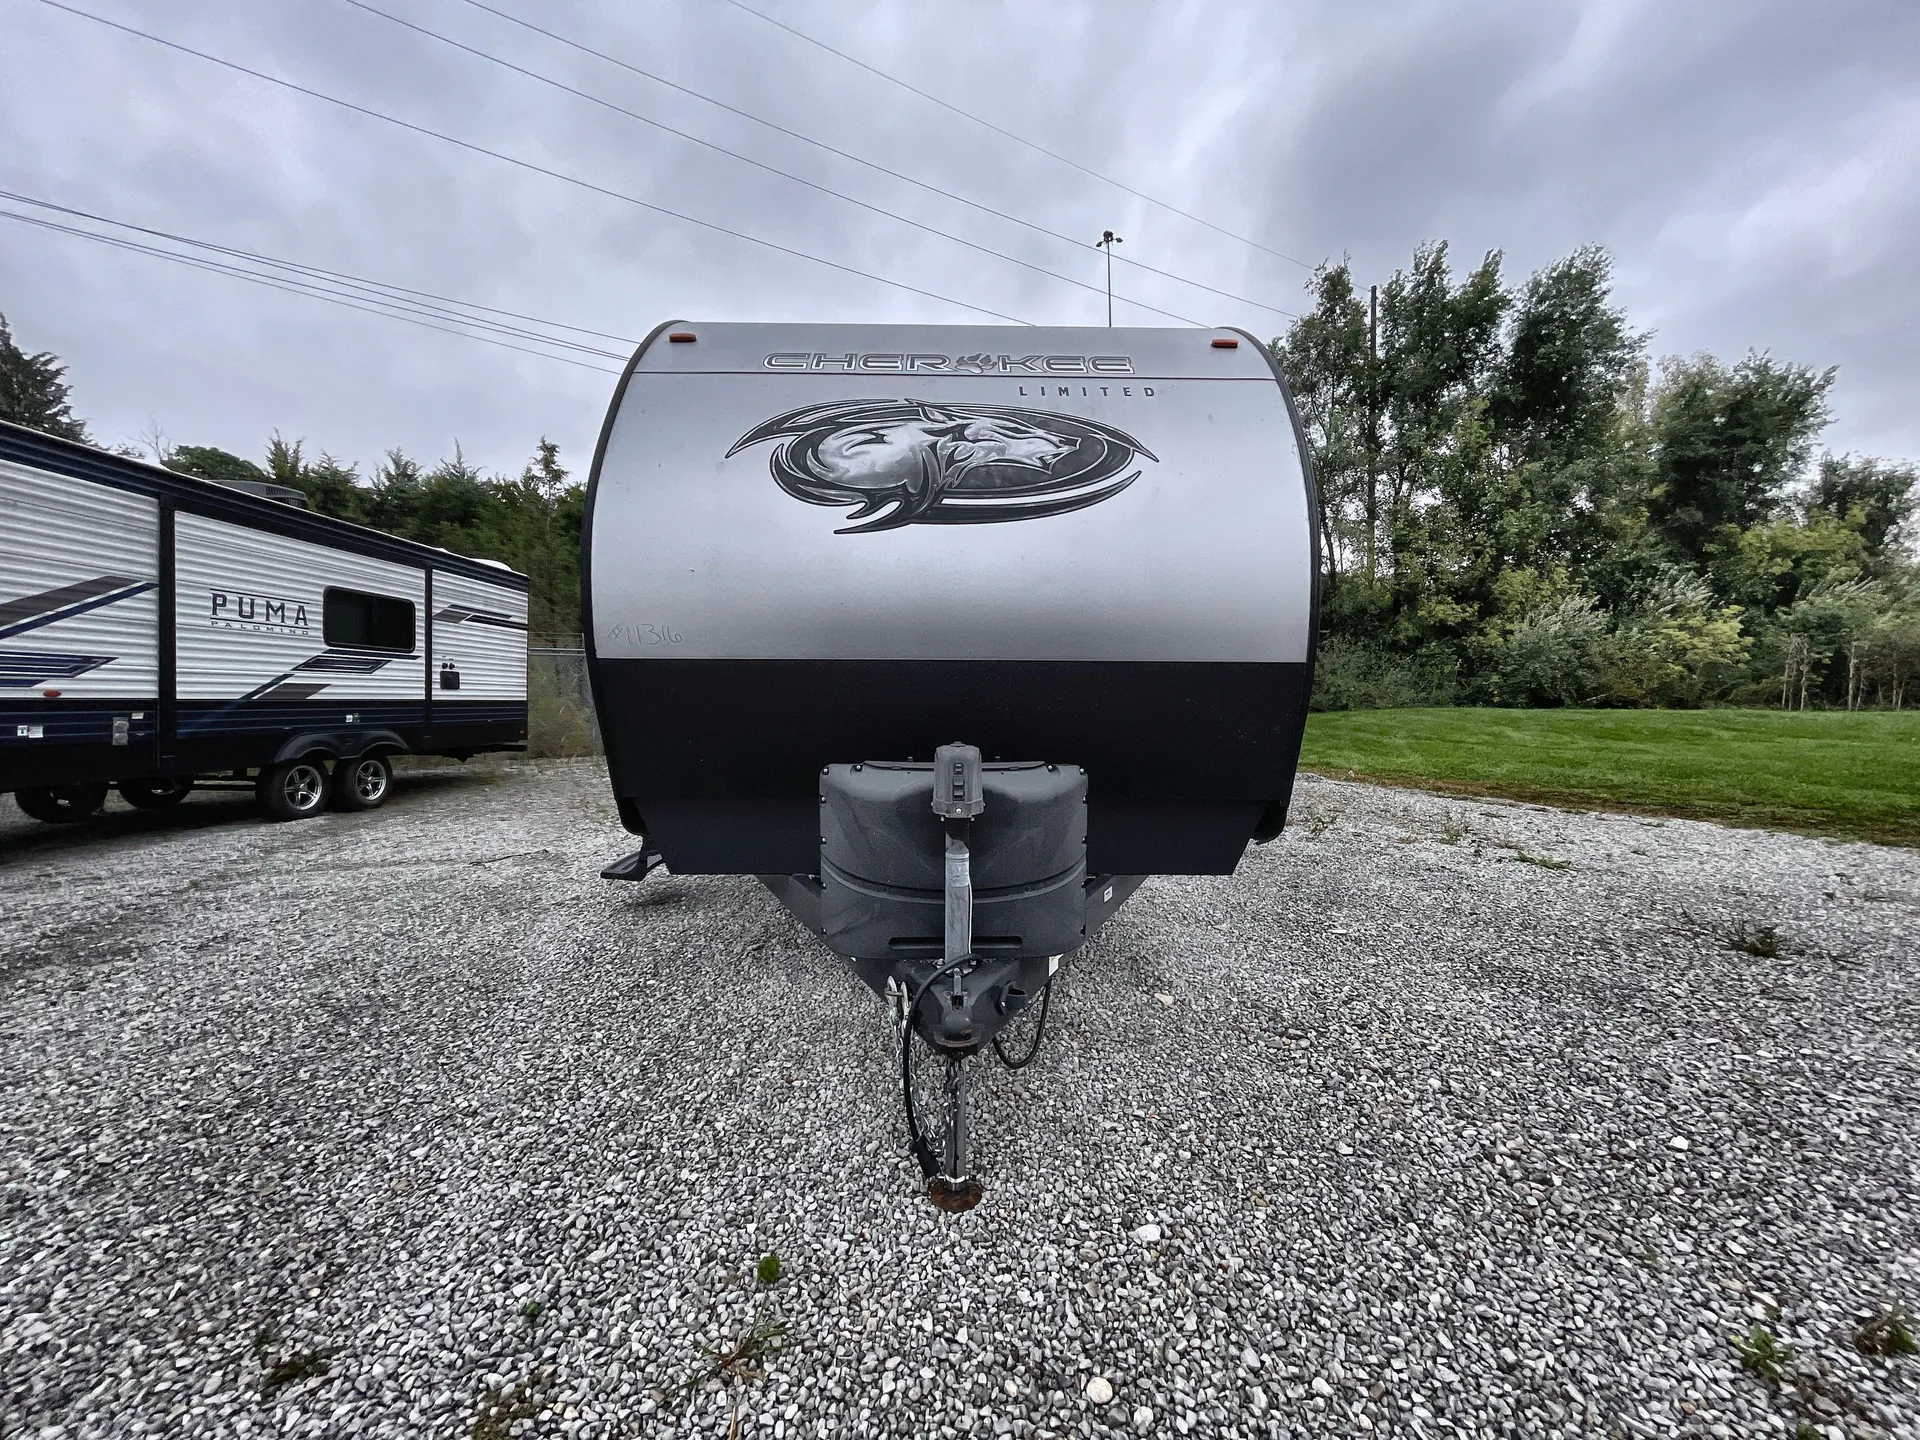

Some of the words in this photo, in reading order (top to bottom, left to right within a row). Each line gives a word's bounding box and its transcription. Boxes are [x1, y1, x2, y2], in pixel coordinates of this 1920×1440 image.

[1018, 386, 1156, 398] LIMITED
[211, 592, 309, 626] PUMA
[210, 620, 309, 636] PALOMINO
